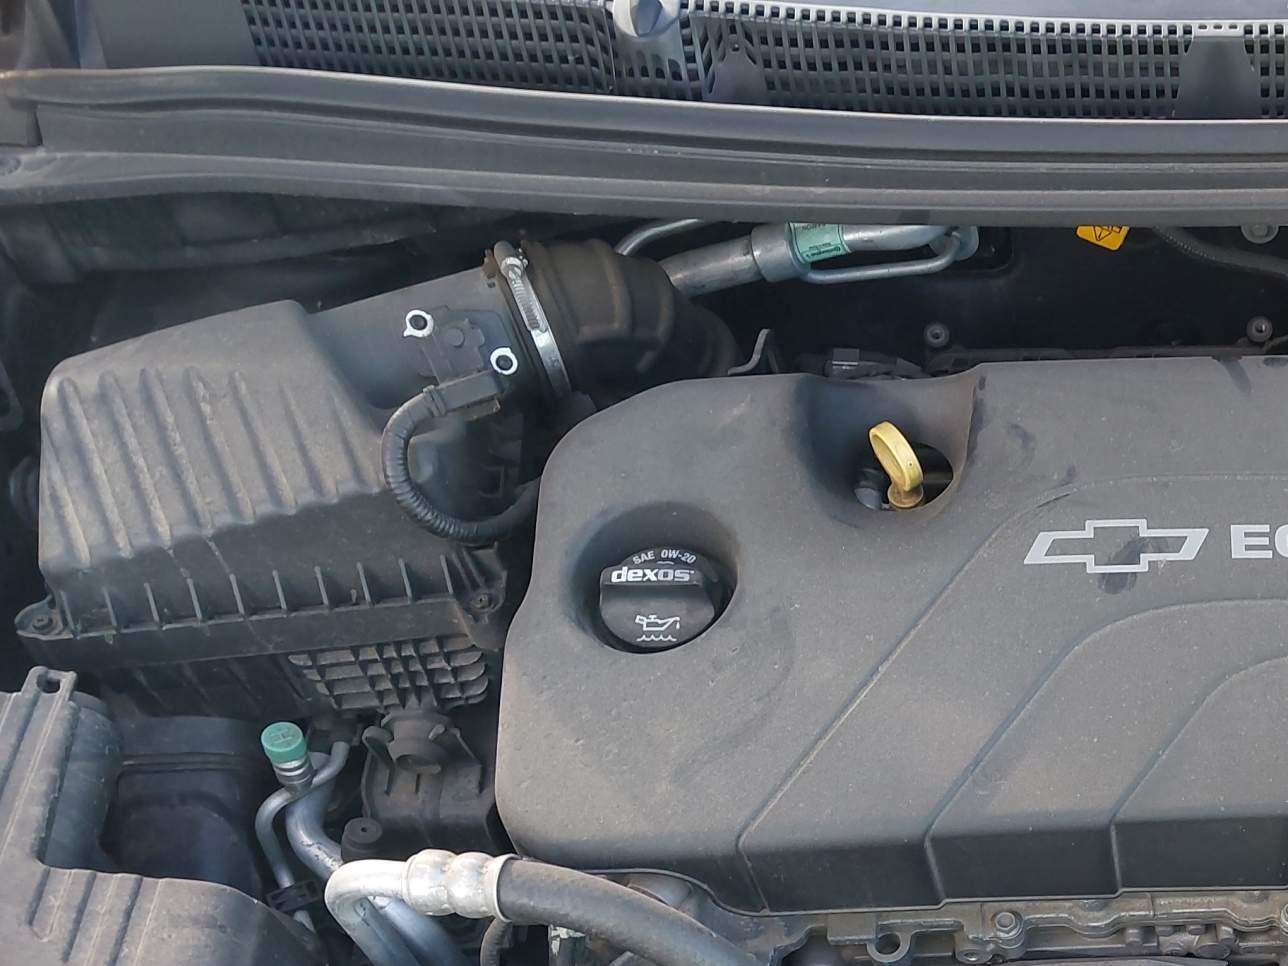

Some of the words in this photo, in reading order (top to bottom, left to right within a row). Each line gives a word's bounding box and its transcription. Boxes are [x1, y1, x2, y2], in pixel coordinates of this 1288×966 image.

[632, 551, 656, 565] SAE
[661, 549, 697, 564] 0W-20
[611, 566, 690, 583] dexos
